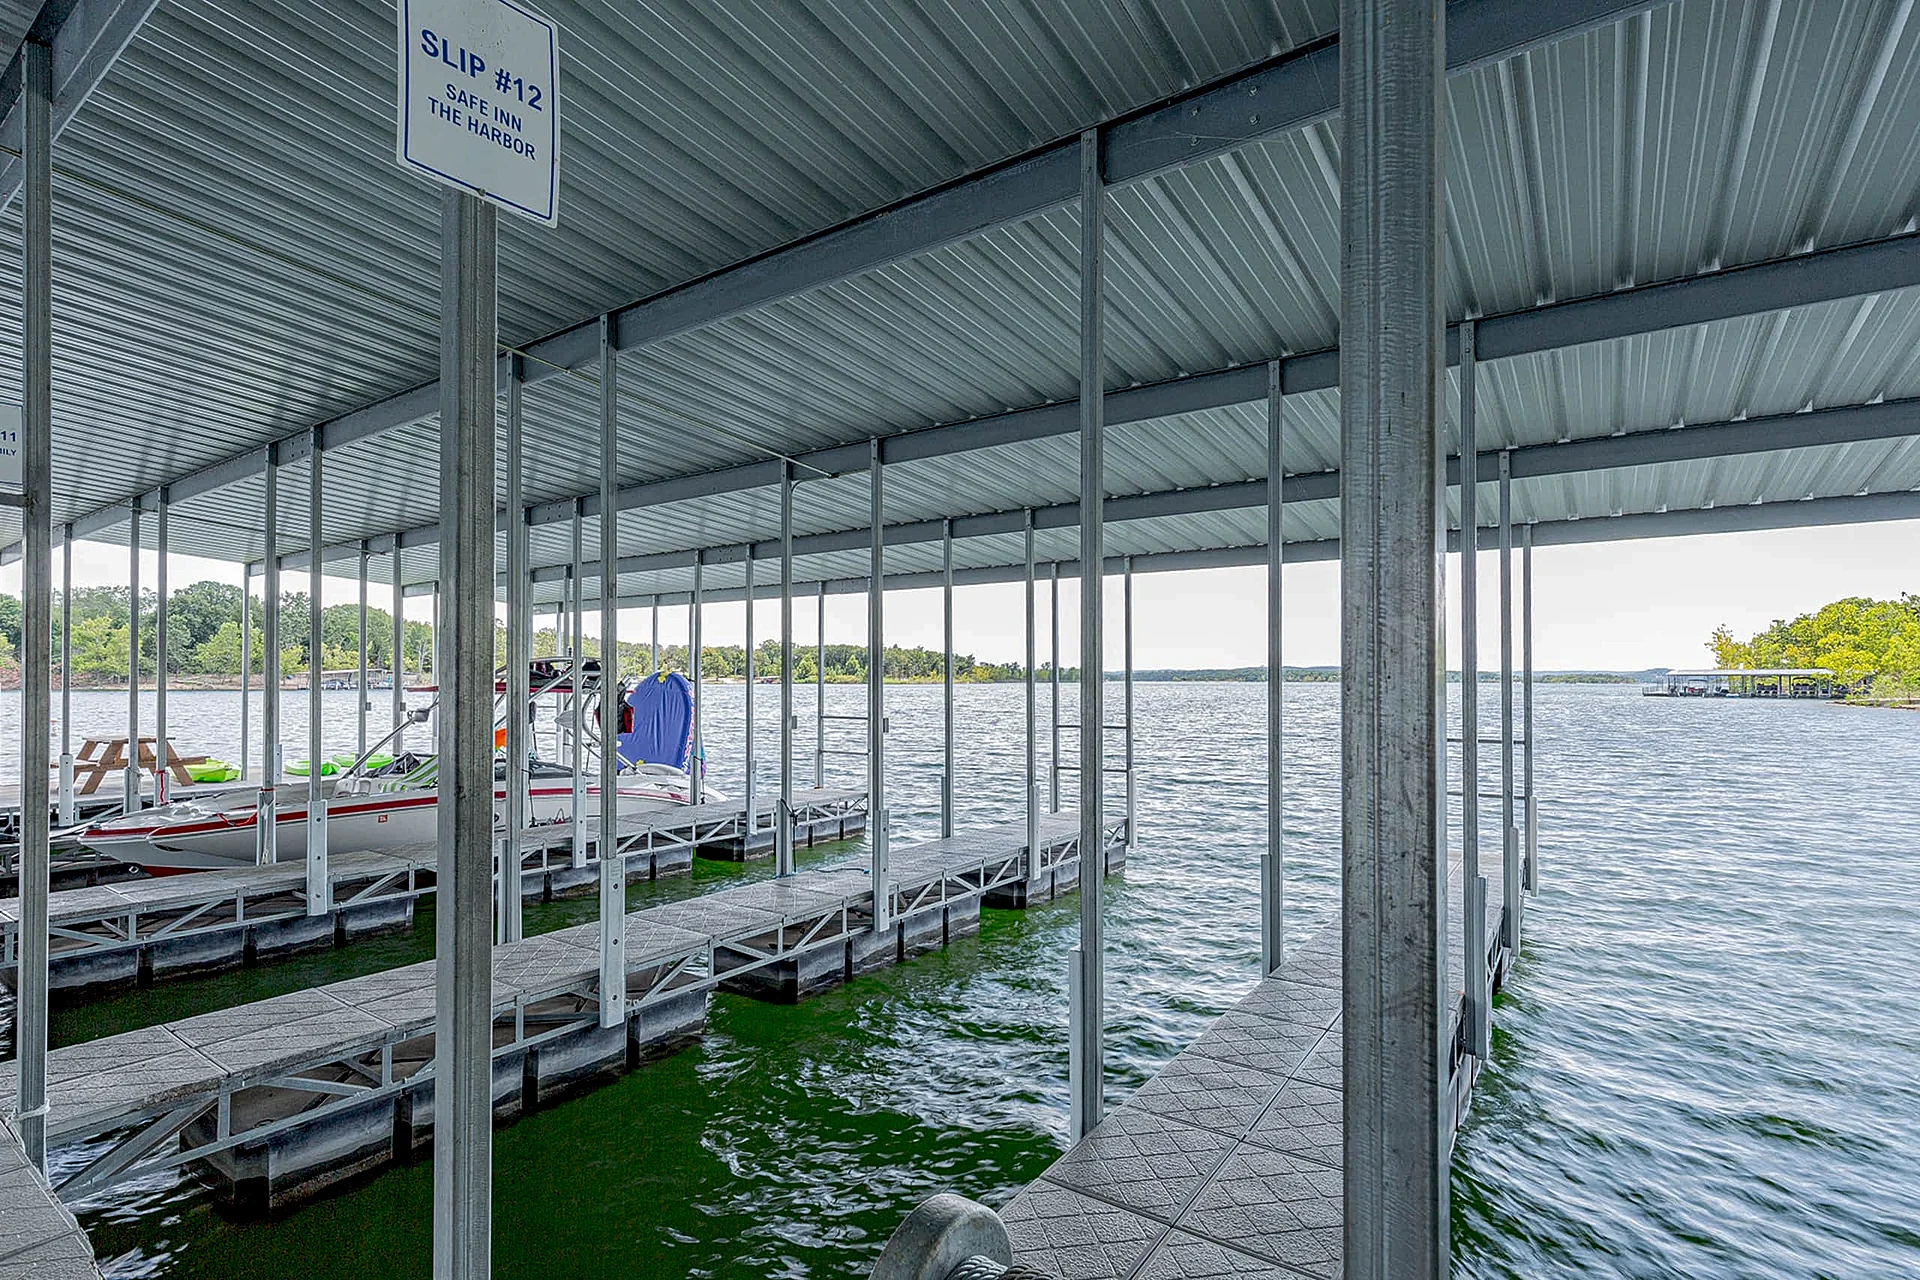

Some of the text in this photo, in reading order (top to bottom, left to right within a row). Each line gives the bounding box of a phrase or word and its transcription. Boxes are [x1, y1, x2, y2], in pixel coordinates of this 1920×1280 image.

[421, 29, 542, 112] SLIP #12
[428, 96, 536, 161] THE HARBOR
[446, 84, 522, 133] SAFE INN
